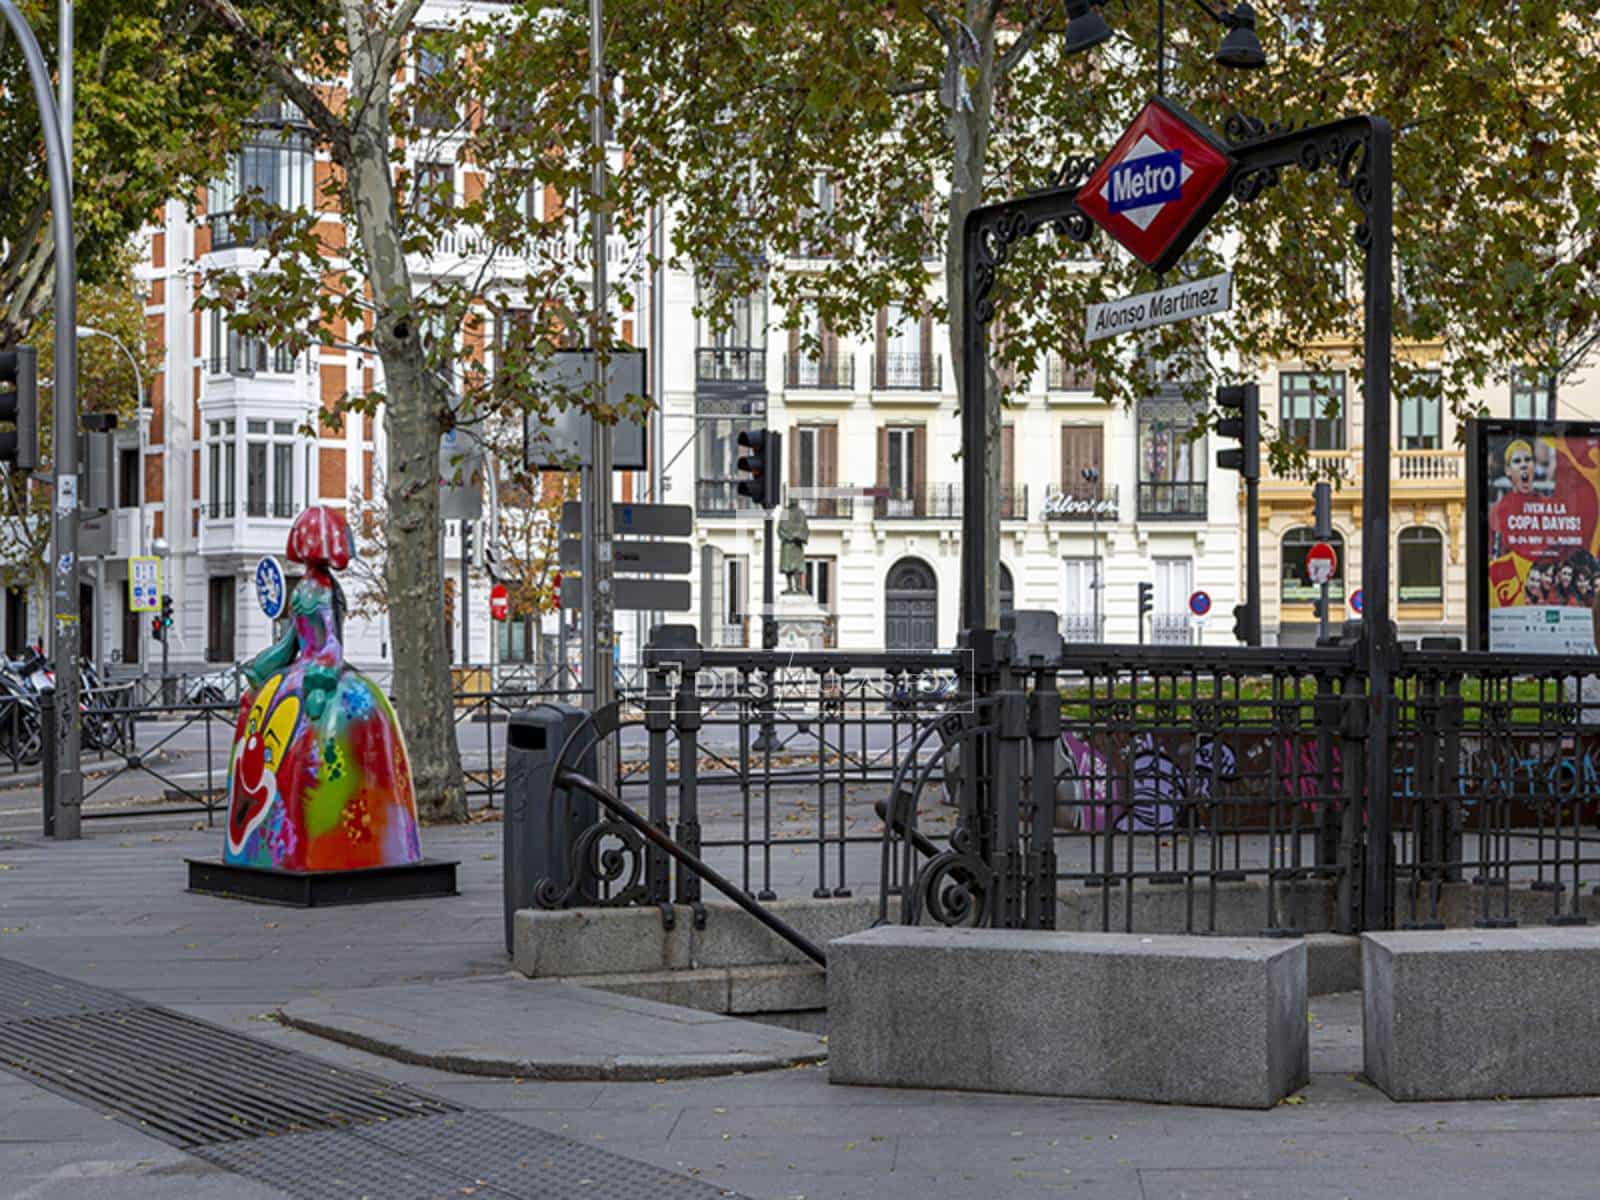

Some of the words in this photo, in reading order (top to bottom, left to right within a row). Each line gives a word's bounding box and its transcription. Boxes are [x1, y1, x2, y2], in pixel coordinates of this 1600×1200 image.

[1112, 165, 1176, 202] Metro
[1095, 303, 1146, 331] Alonso
[1149, 286, 1219, 319] Martínez
[1507, 514, 1540, 530] COPA
